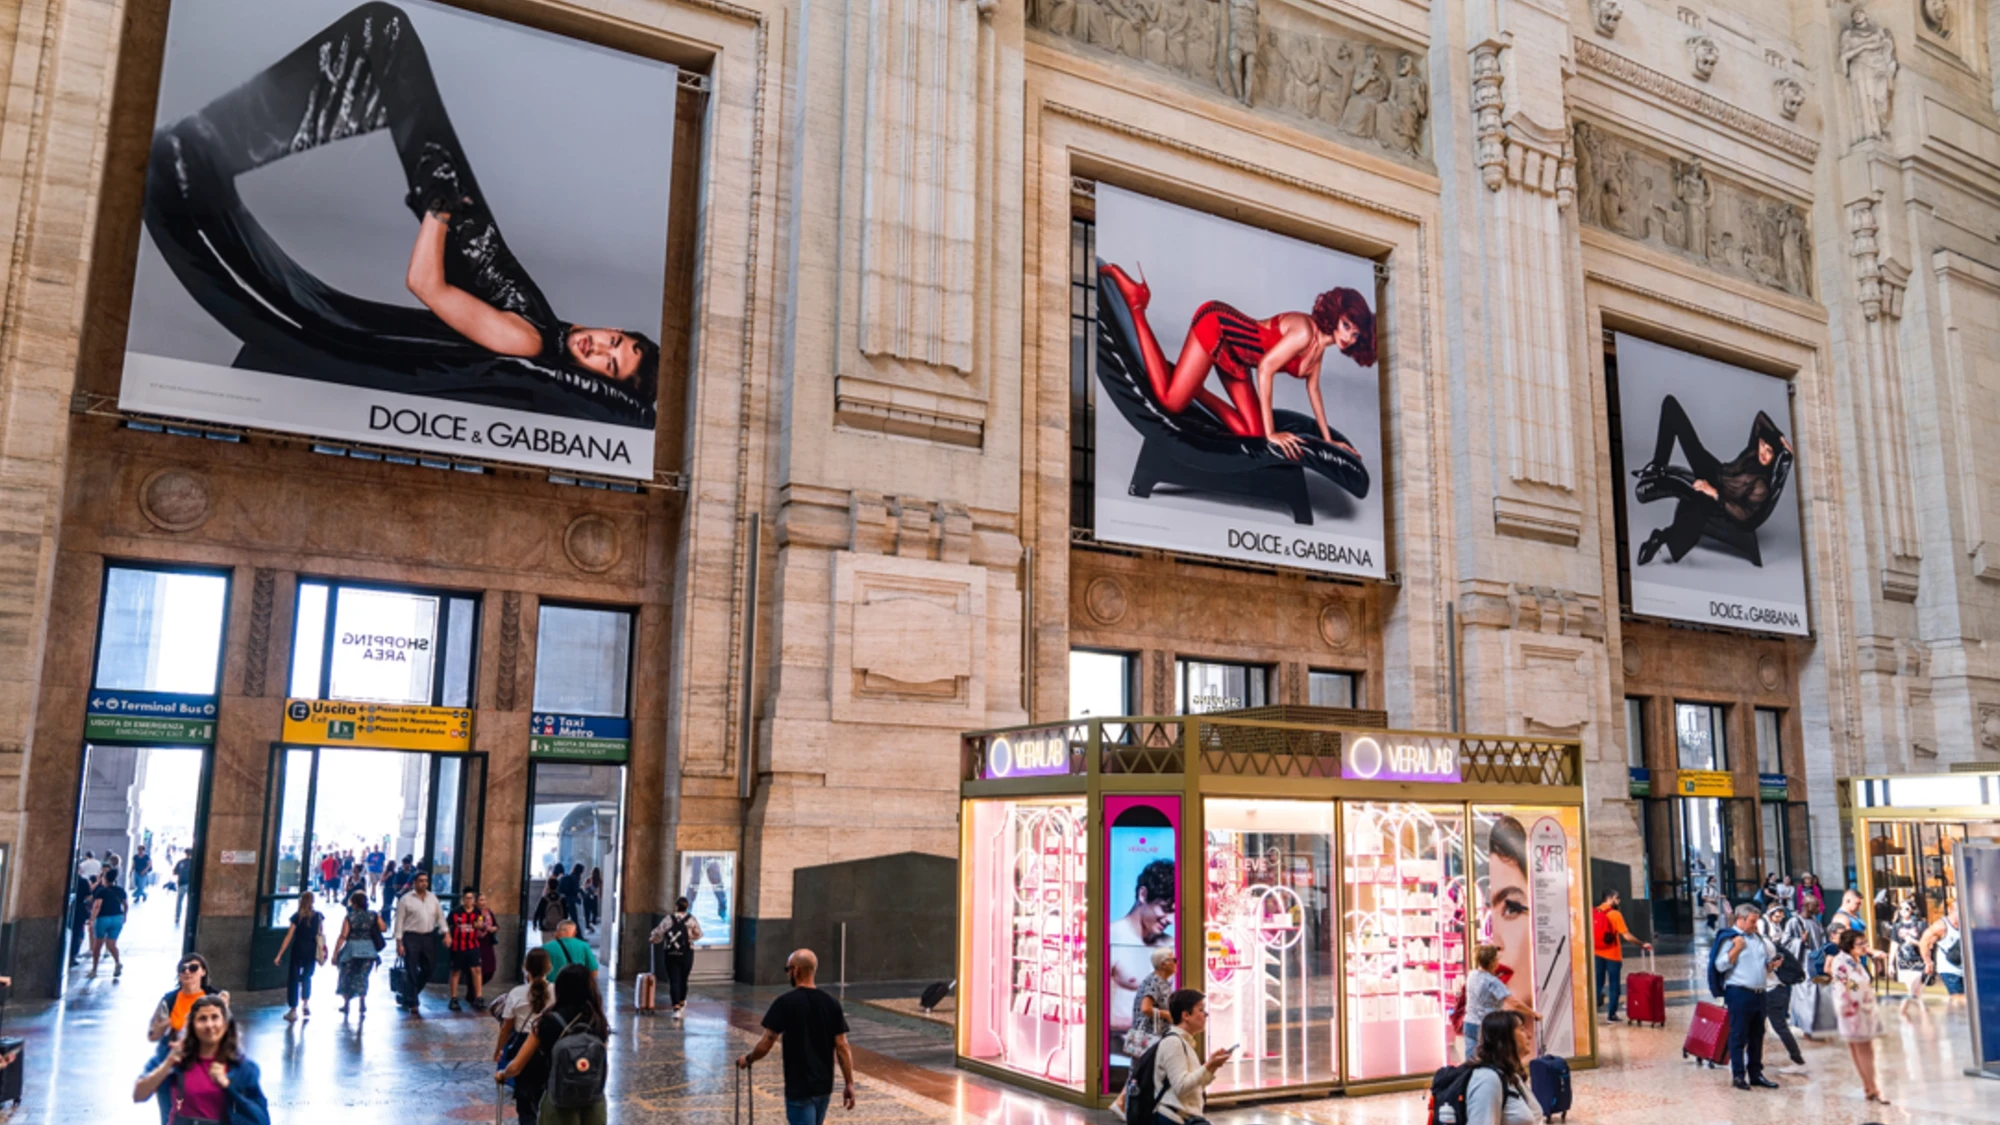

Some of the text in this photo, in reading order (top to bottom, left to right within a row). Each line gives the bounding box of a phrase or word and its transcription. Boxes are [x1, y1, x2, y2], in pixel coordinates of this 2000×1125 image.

[369, 404, 632, 465] DOLCE & GABBANA
[1228, 528, 1373, 568] DOLCE & GABBANA
[1710, 600, 1743, 620] DOLCE
[1750, 606, 1800, 627] GABBANA
[120, 700, 202, 714] Terminal Bus
[312, 702, 356, 715] Uscita
[90, 718, 184, 730] USCITA DI EMERGENZA
[311, 714, 327, 723] Exit
[559, 716, 585, 727] Taxi
[115, 728, 184, 738] EMERGENCY EXIT
[559, 727, 594, 738] Metro
[1014, 738, 1064, 769] VERALAB
[1388, 744, 1453, 775] VERALAB
[1534, 844, 1563, 858] OVER
